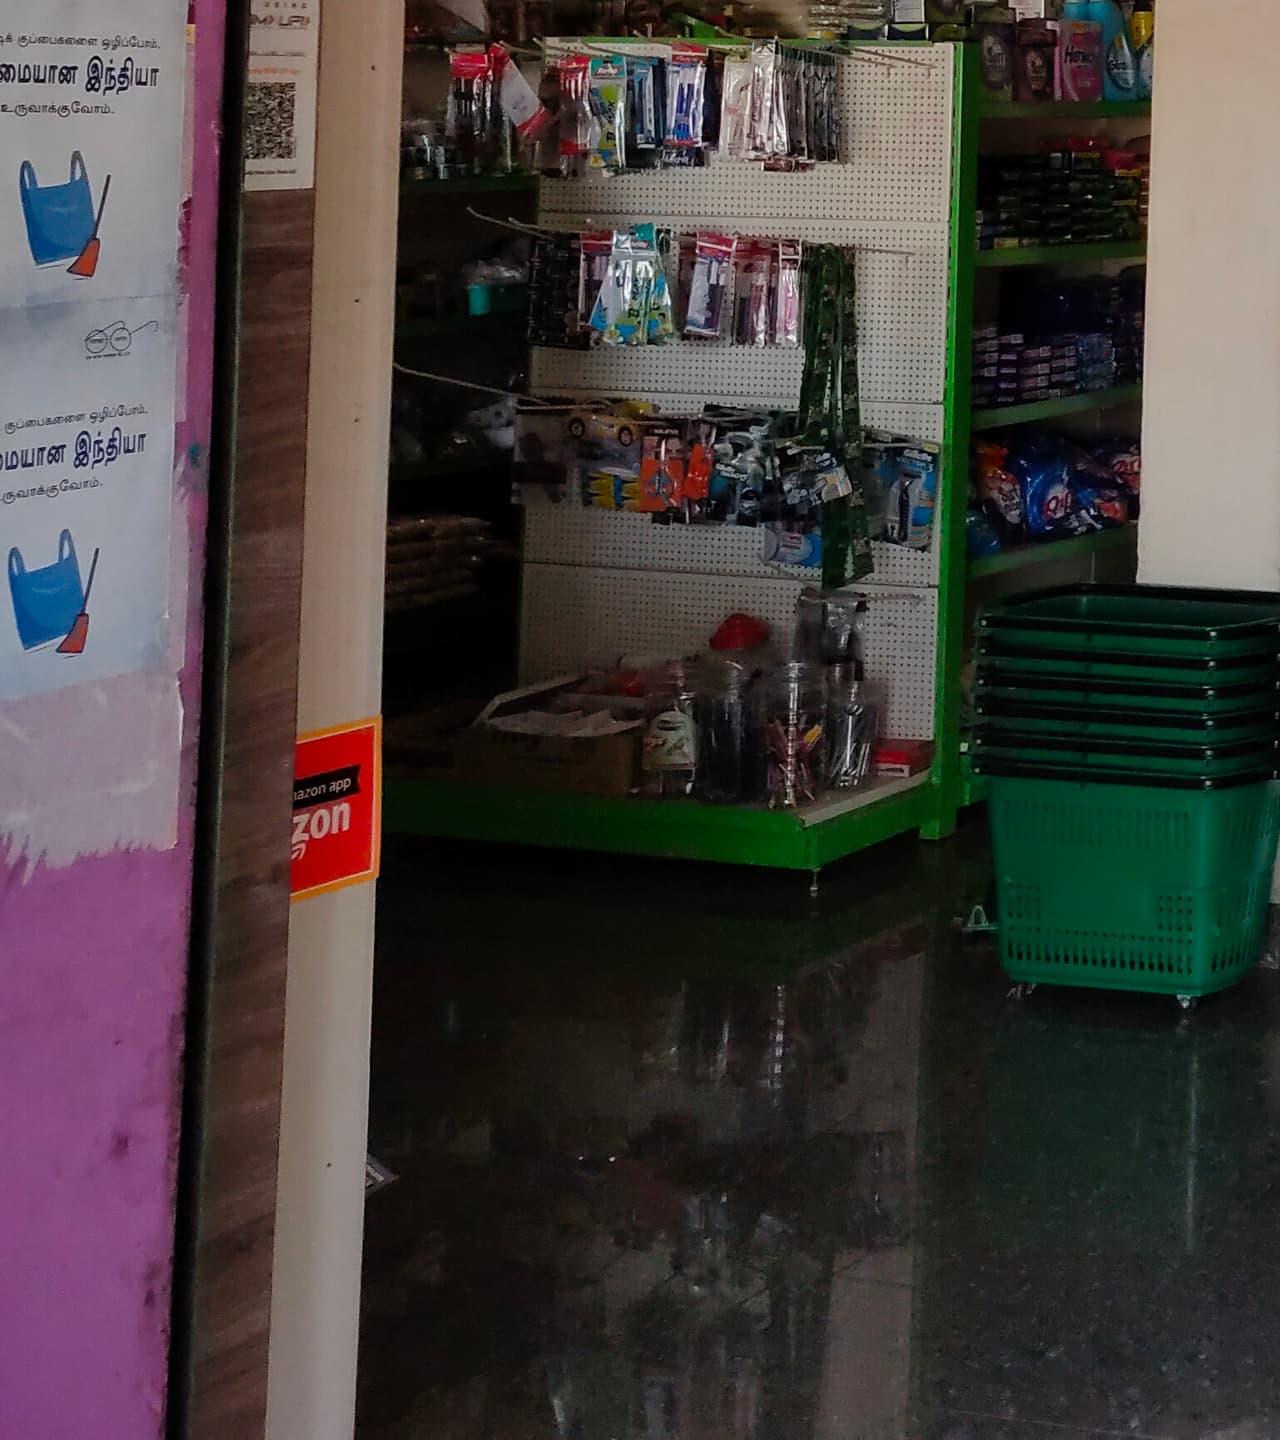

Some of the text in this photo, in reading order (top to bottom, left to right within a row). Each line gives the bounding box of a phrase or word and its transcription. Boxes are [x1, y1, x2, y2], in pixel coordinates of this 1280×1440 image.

[85, 54, 160, 97] இந்தியா
[73, 426, 147, 471] இந்தியா
[328, 777, 352, 797] app
